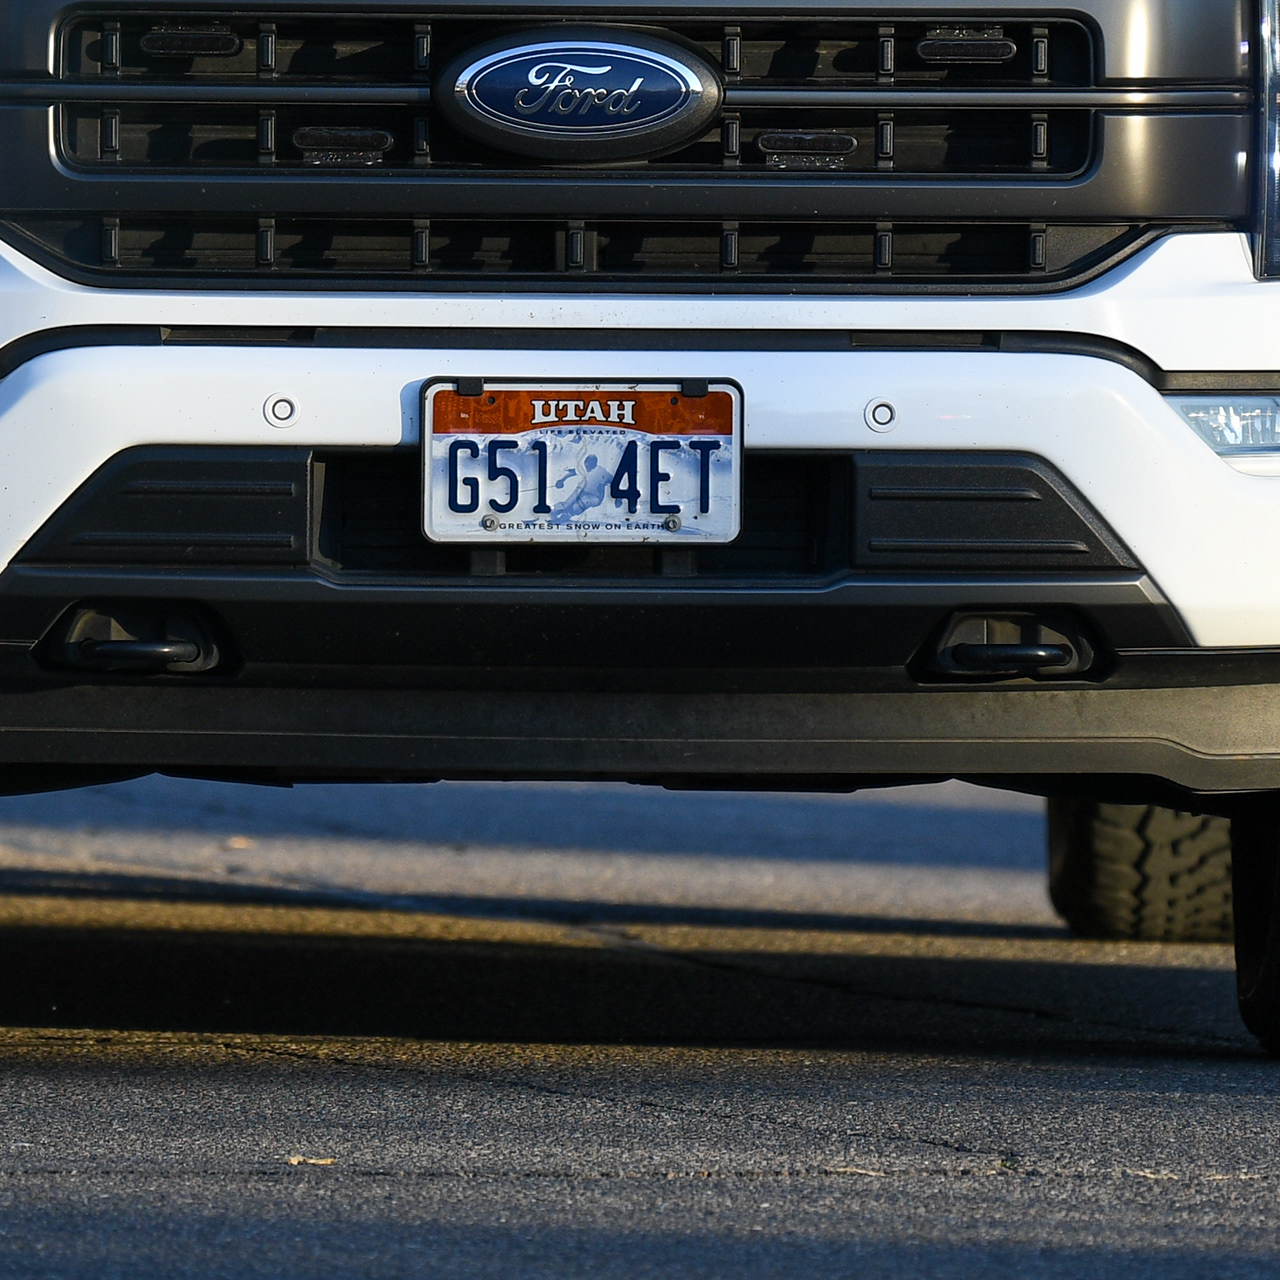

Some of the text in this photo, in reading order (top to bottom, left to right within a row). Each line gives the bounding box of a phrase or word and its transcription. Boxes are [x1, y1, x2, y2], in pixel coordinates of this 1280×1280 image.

[514, 62, 645, 115] Ford
[530, 400, 636, 424] UTAH
[448, 440, 722, 514] G51 4ET
[499, 522, 560, 530] GREATEST
